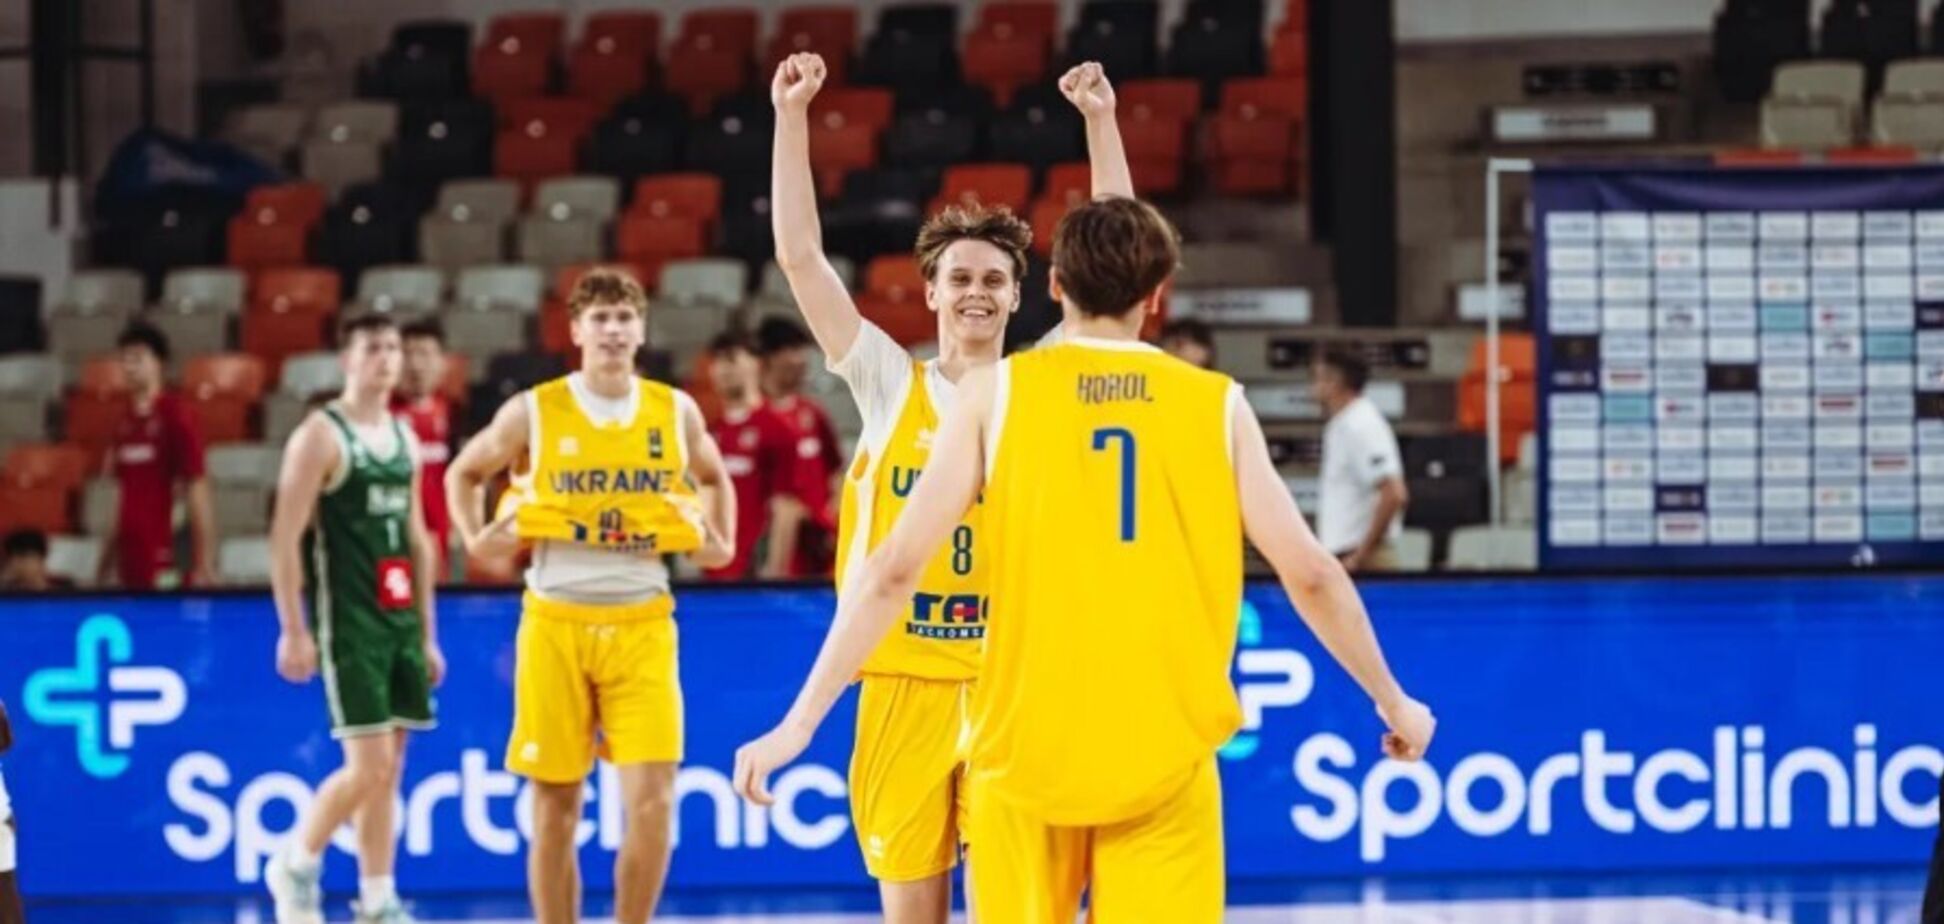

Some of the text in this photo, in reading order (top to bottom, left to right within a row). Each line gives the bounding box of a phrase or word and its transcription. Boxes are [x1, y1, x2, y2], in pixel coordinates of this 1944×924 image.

[550, 469, 673, 493] UKRAINE
[1092, 427, 1136, 542] 7
[952, 525, 972, 575] 8
[163, 749, 850, 883] Sprtlnic
[1290, 723, 1944, 862] Sportclinic
